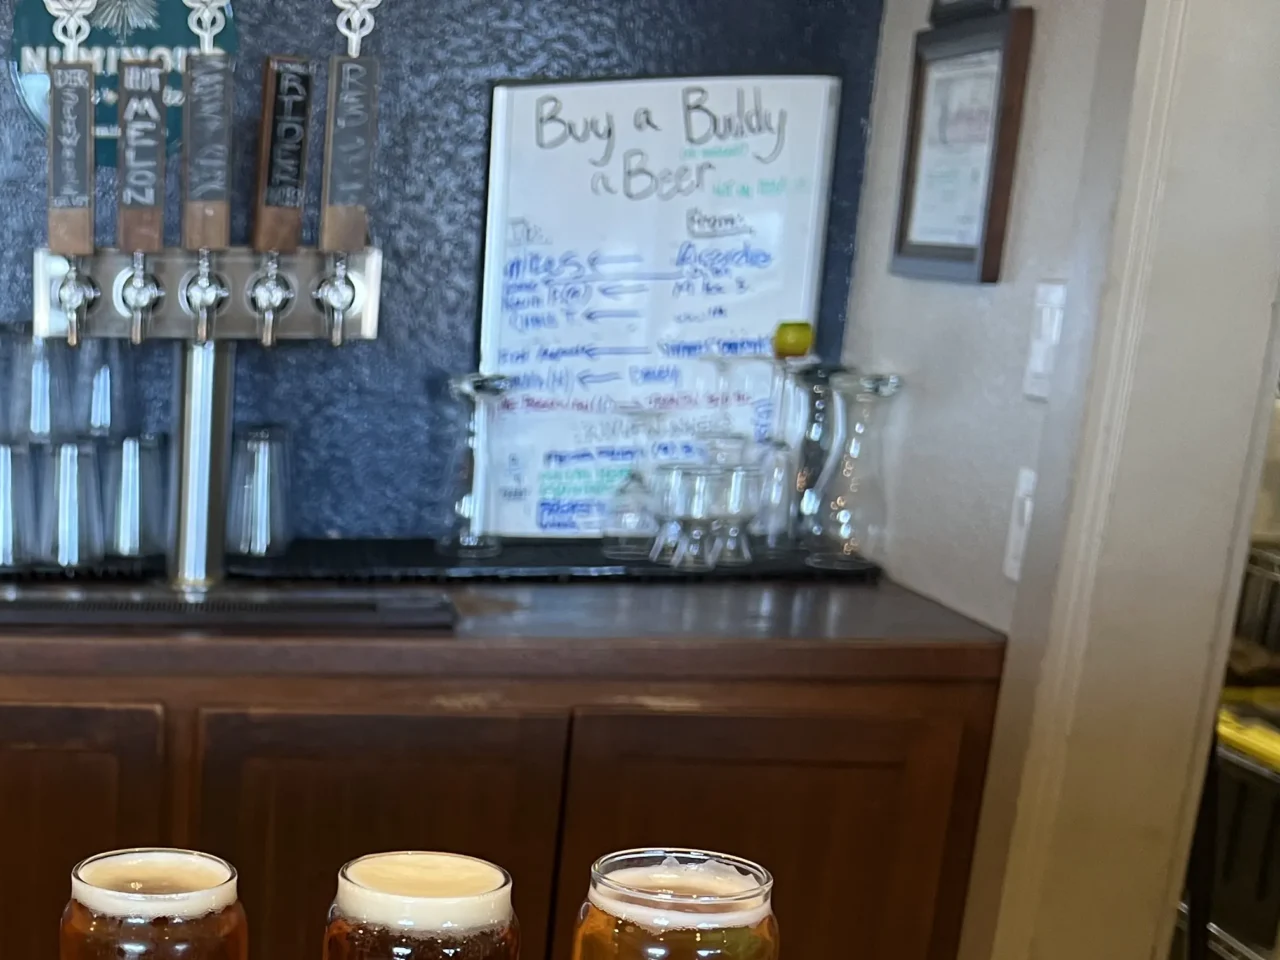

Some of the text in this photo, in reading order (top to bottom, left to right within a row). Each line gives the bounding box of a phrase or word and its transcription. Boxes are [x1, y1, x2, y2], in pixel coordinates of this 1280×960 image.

[535, 86, 788, 167] Buy a Buddy
[591, 170, 618, 195] a
[623, 149, 716, 201] Beer
